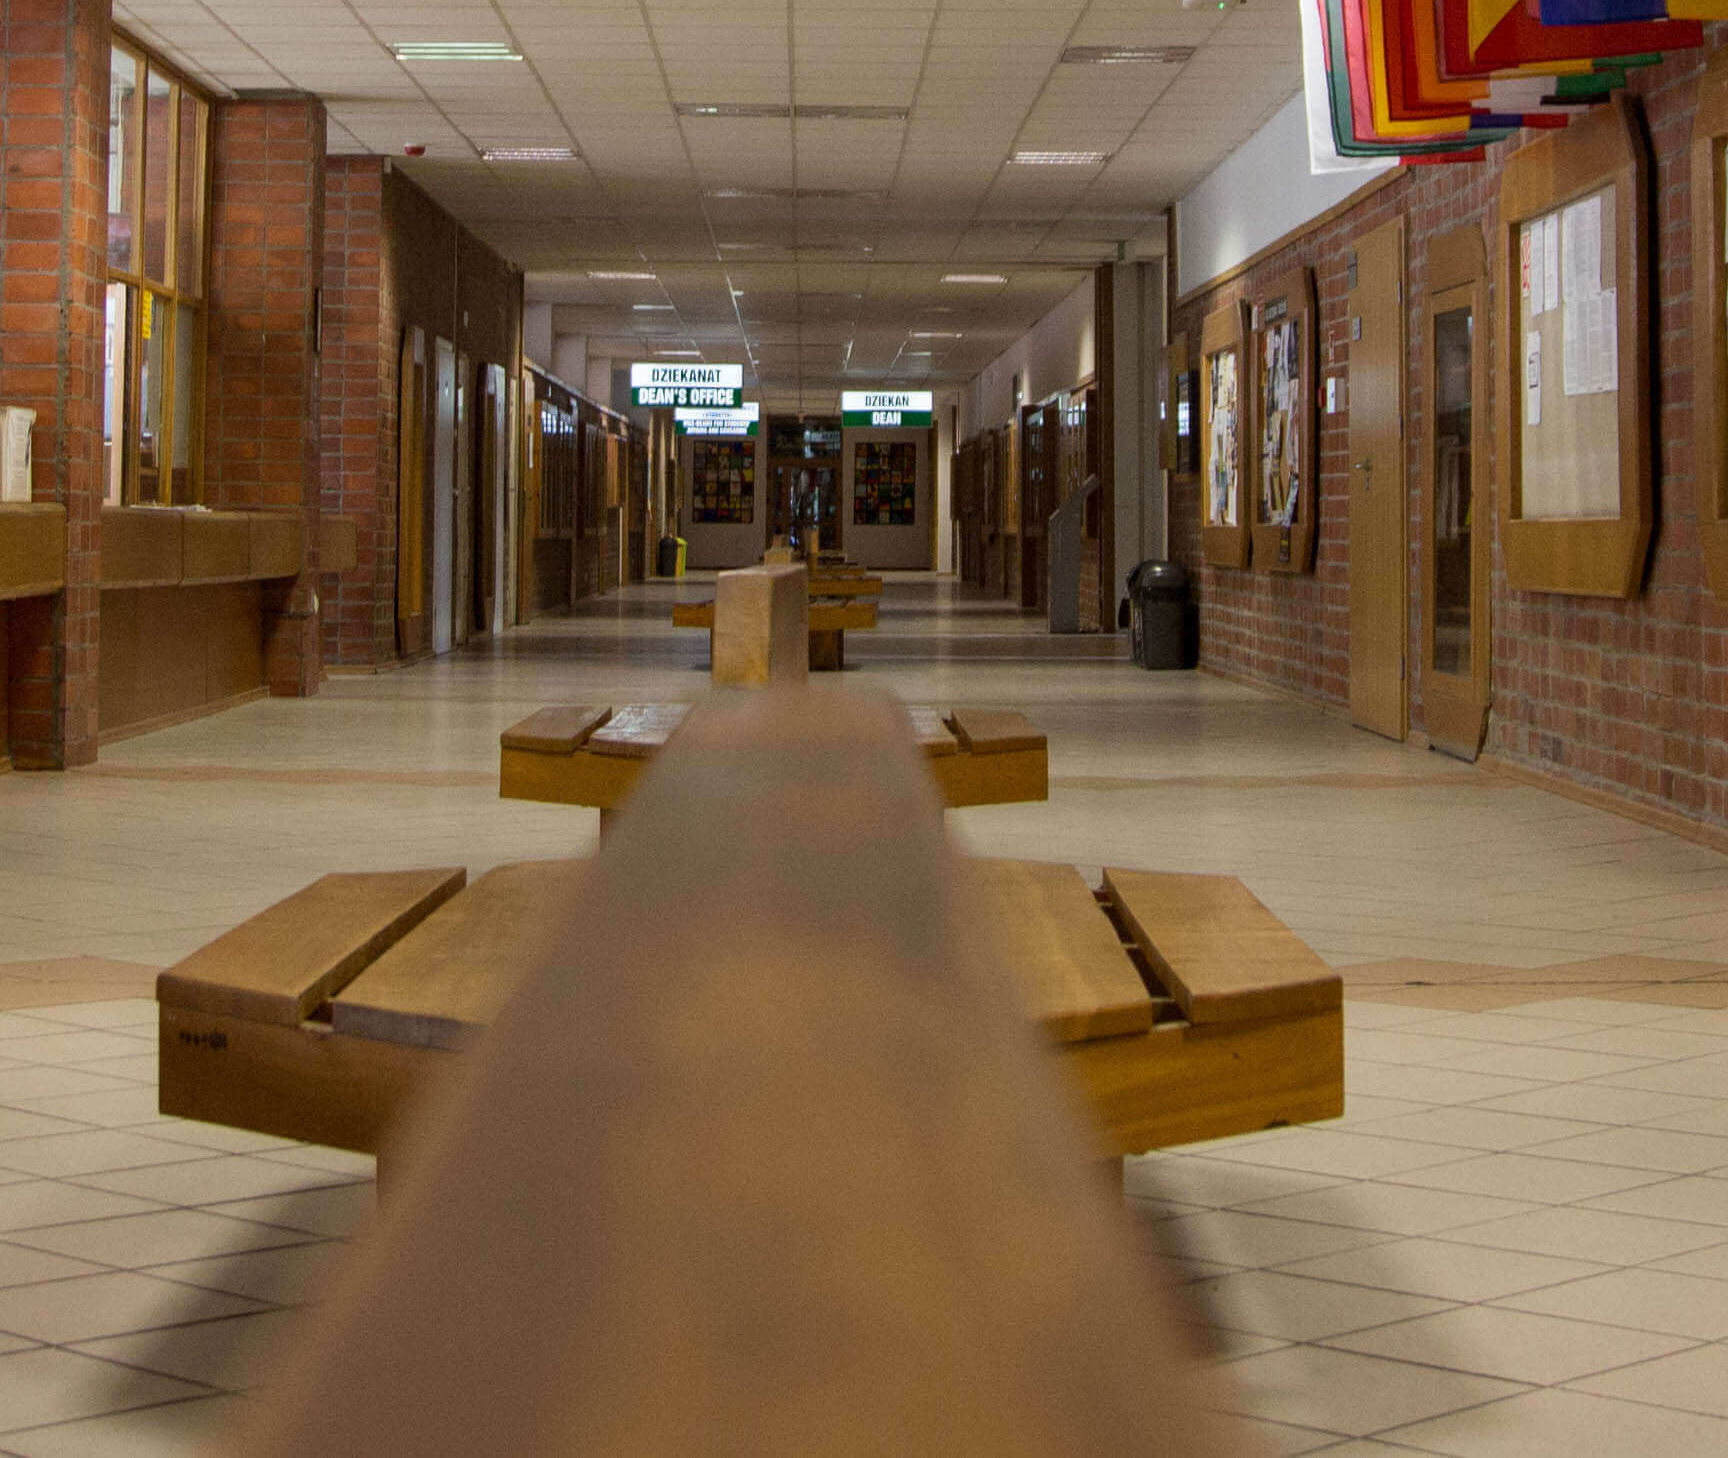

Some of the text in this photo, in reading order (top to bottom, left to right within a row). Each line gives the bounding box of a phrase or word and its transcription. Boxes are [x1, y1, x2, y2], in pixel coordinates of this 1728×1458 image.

[651, 368, 721, 383] DZIEKANAT
[638, 388, 734, 405] DEAN'S OFFICE
[865, 395, 909, 407] DZIEKAN
[872, 411, 902, 425] DEAN
